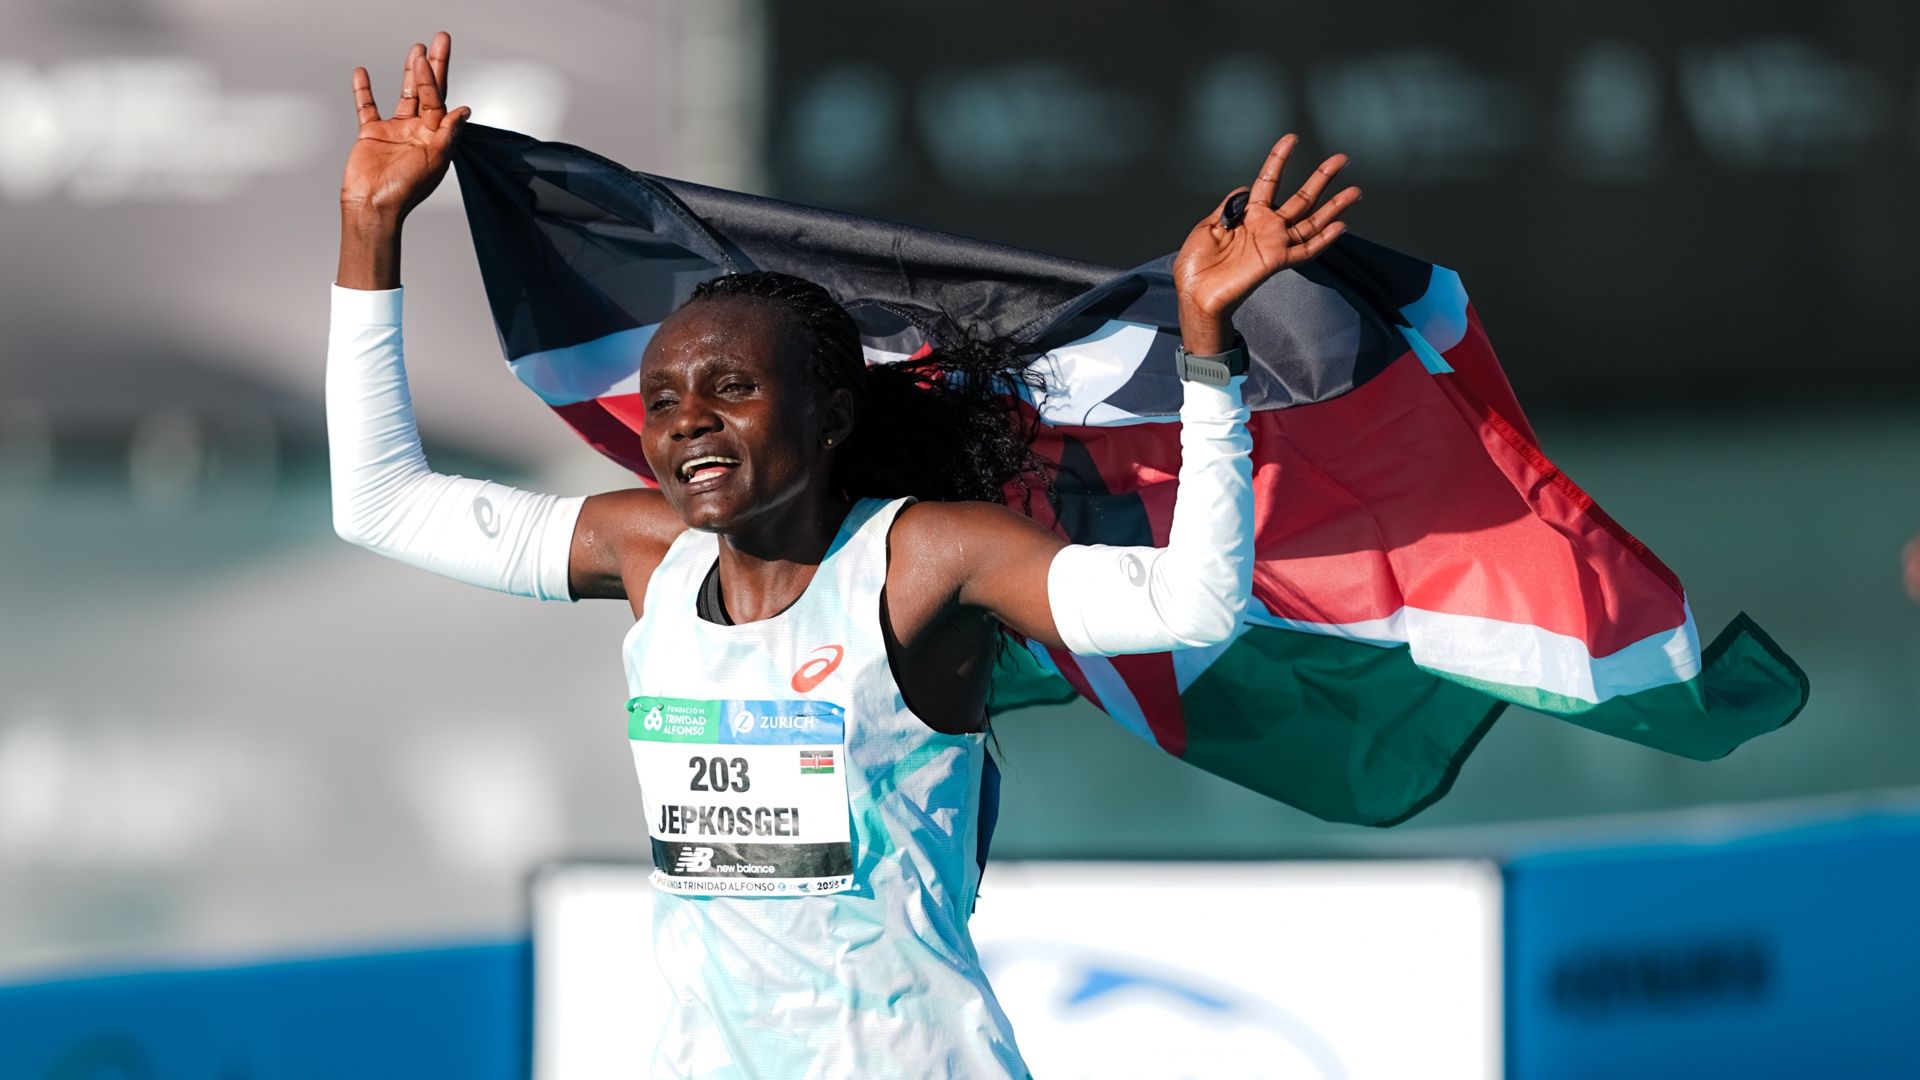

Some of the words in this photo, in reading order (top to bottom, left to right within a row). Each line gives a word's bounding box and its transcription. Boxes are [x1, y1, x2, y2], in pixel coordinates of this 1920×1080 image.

[665, 714, 706, 725] TRINIDAD
[760, 715, 815, 729] ZURICH
[663, 725, 704, 735] ALFONSO
[689, 756, 751, 793] 203
[659, 804, 799, 837] JEPKOSGEI
[716, 864, 736, 873] new
[737, 863, 775, 874] balance
[684, 881, 727, 891] TRINIDAD
[728, 882, 775, 891] ALFONSO
